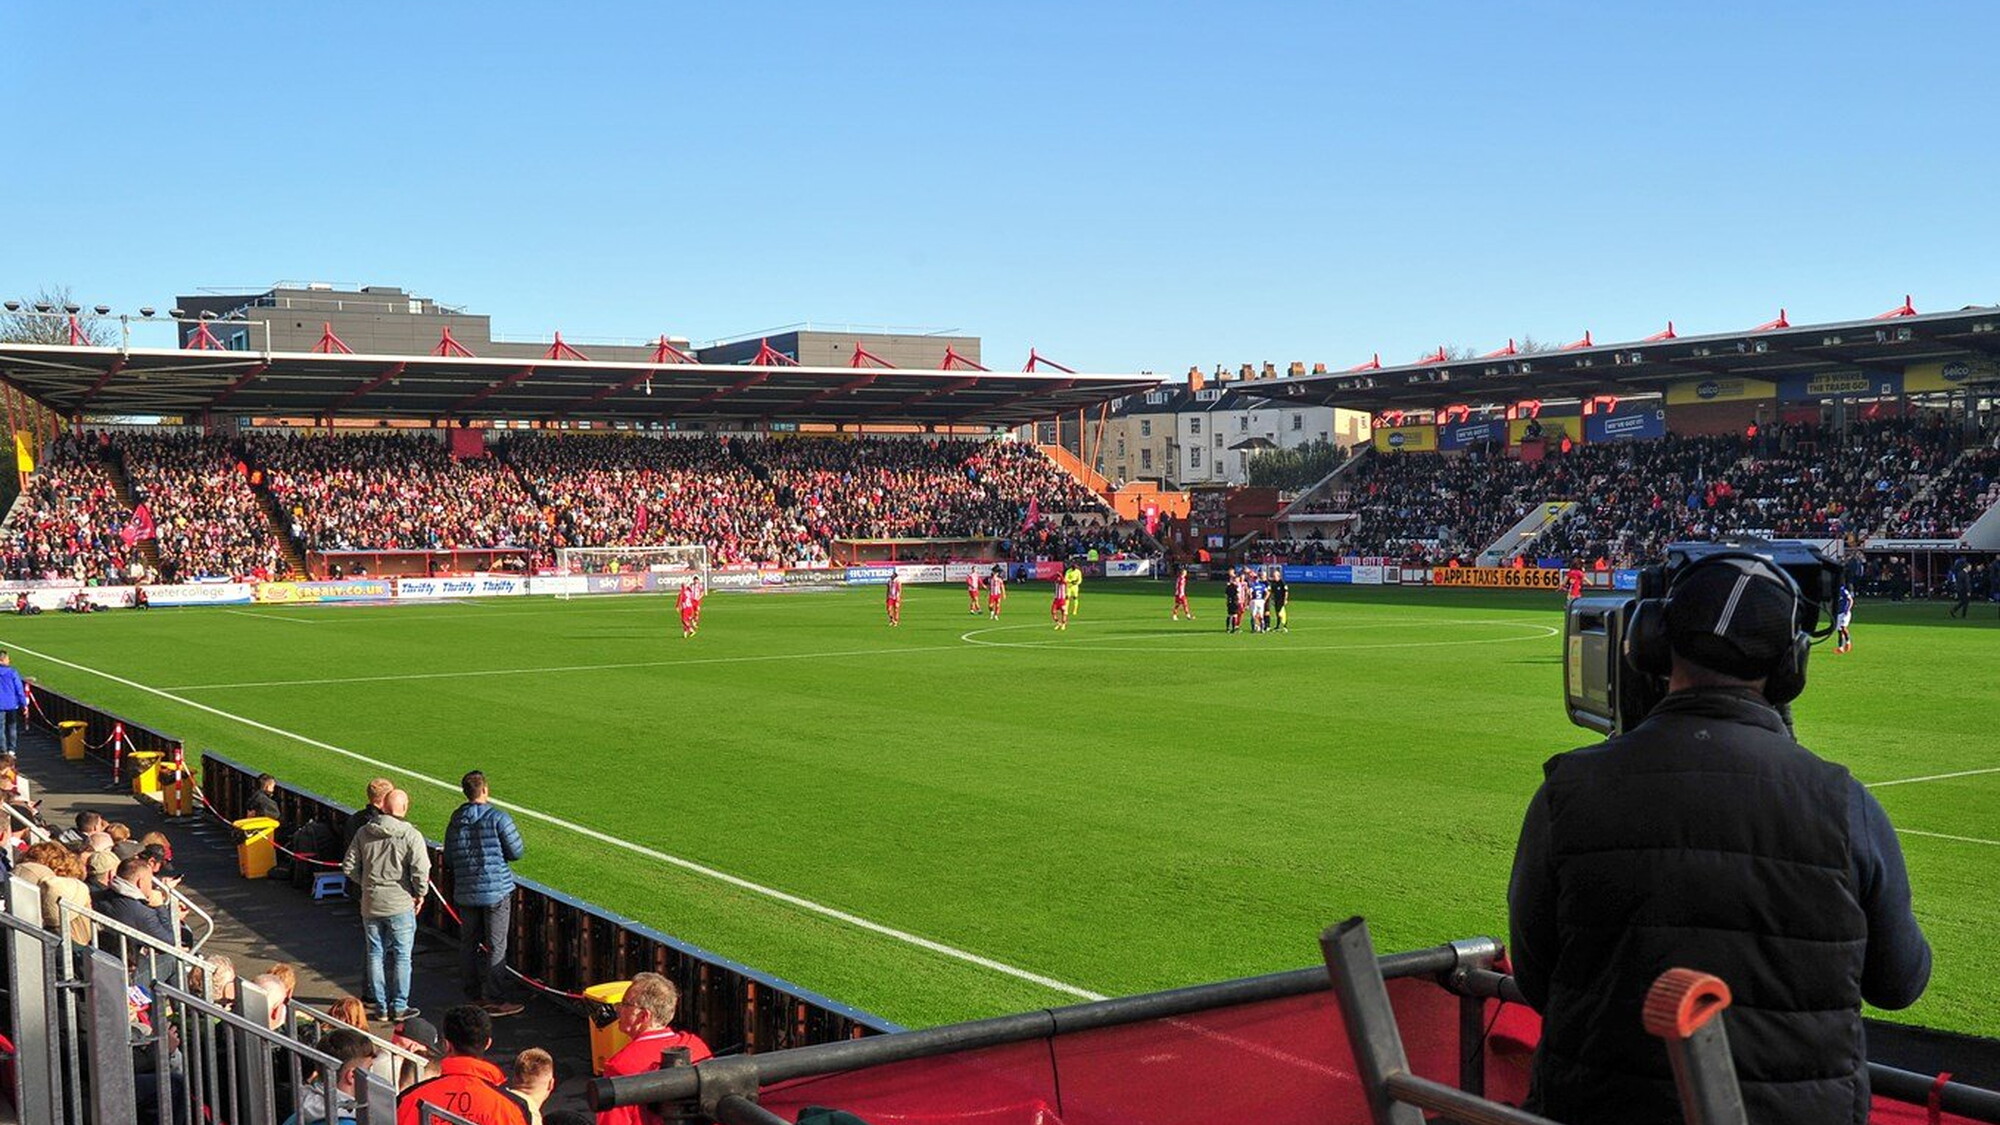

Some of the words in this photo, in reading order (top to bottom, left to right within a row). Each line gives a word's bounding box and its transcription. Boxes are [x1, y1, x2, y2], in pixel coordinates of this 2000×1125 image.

[1809, 383, 1823, 393] THE
[1825, 382, 1851, 391] TRADE
[712, 573, 759, 586] carpetright
[849, 568, 894, 578] HUNTERS
[1443, 569, 1471, 584] APPLE
[1473, 570, 1498, 585] TAXIS
[402, 582, 436, 596] Thrifty
[443, 581, 476, 595] Thrifty
[483, 581, 516, 593] Thrifty
[599, 577, 620, 590] sky
[622, 577, 645, 588] bet
[182, 586, 225, 598] college
[1255, 590, 1262, 599] 5
[445, 1091, 472, 1113] 70
